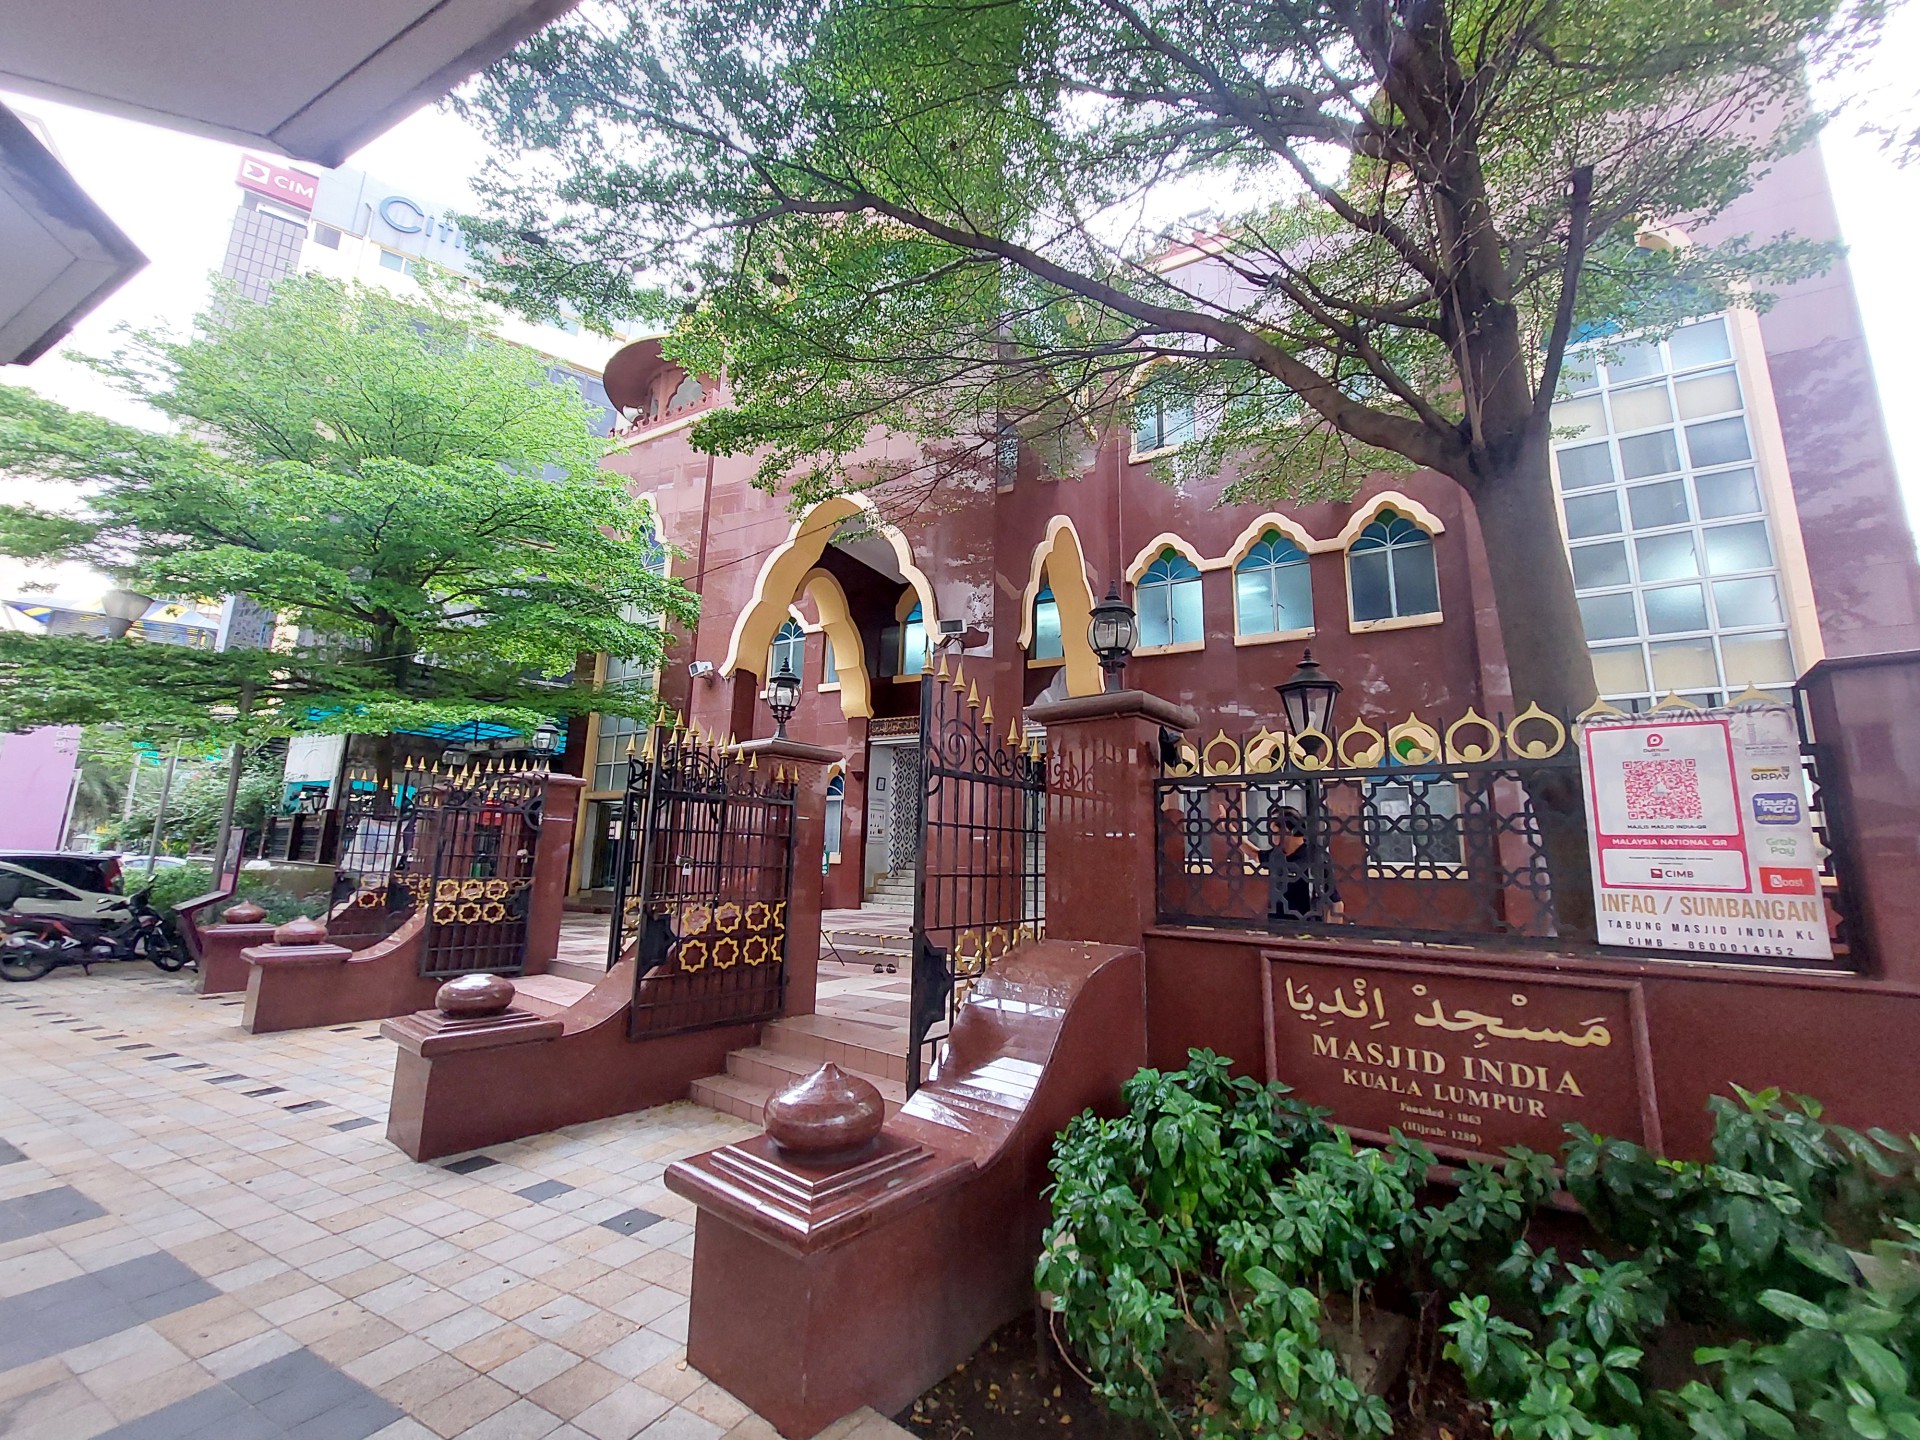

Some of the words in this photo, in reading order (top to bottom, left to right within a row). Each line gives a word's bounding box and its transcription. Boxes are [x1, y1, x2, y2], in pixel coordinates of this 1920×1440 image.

[1751, 773, 1790, 781] QRPAY
[1770, 846, 1795, 857] Pay
[1665, 870, 1694, 878] CIMB
[1601, 893, 1657, 915] INFAQ
[1663, 896, 1673, 914] /
[1680, 896, 1818, 922] SUMBANGAN
[1608, 920, 1662, 931] TABUNG
[1672, 924, 1727, 935] MASJID
[1738, 927, 1784, 938] INDIA
[1796, 931, 1815, 940] KL
[1628, 937, 1663, 947] CIMB
[1688, 941, 1794, 956] 8600014552
[1312, 1033, 1446, 1075] MASJID
[1462, 1055, 1585, 1098] INDIA
[1343, 1068, 1423, 1097] KUALA
[1434, 1083, 1547, 1118] LUMPUR
